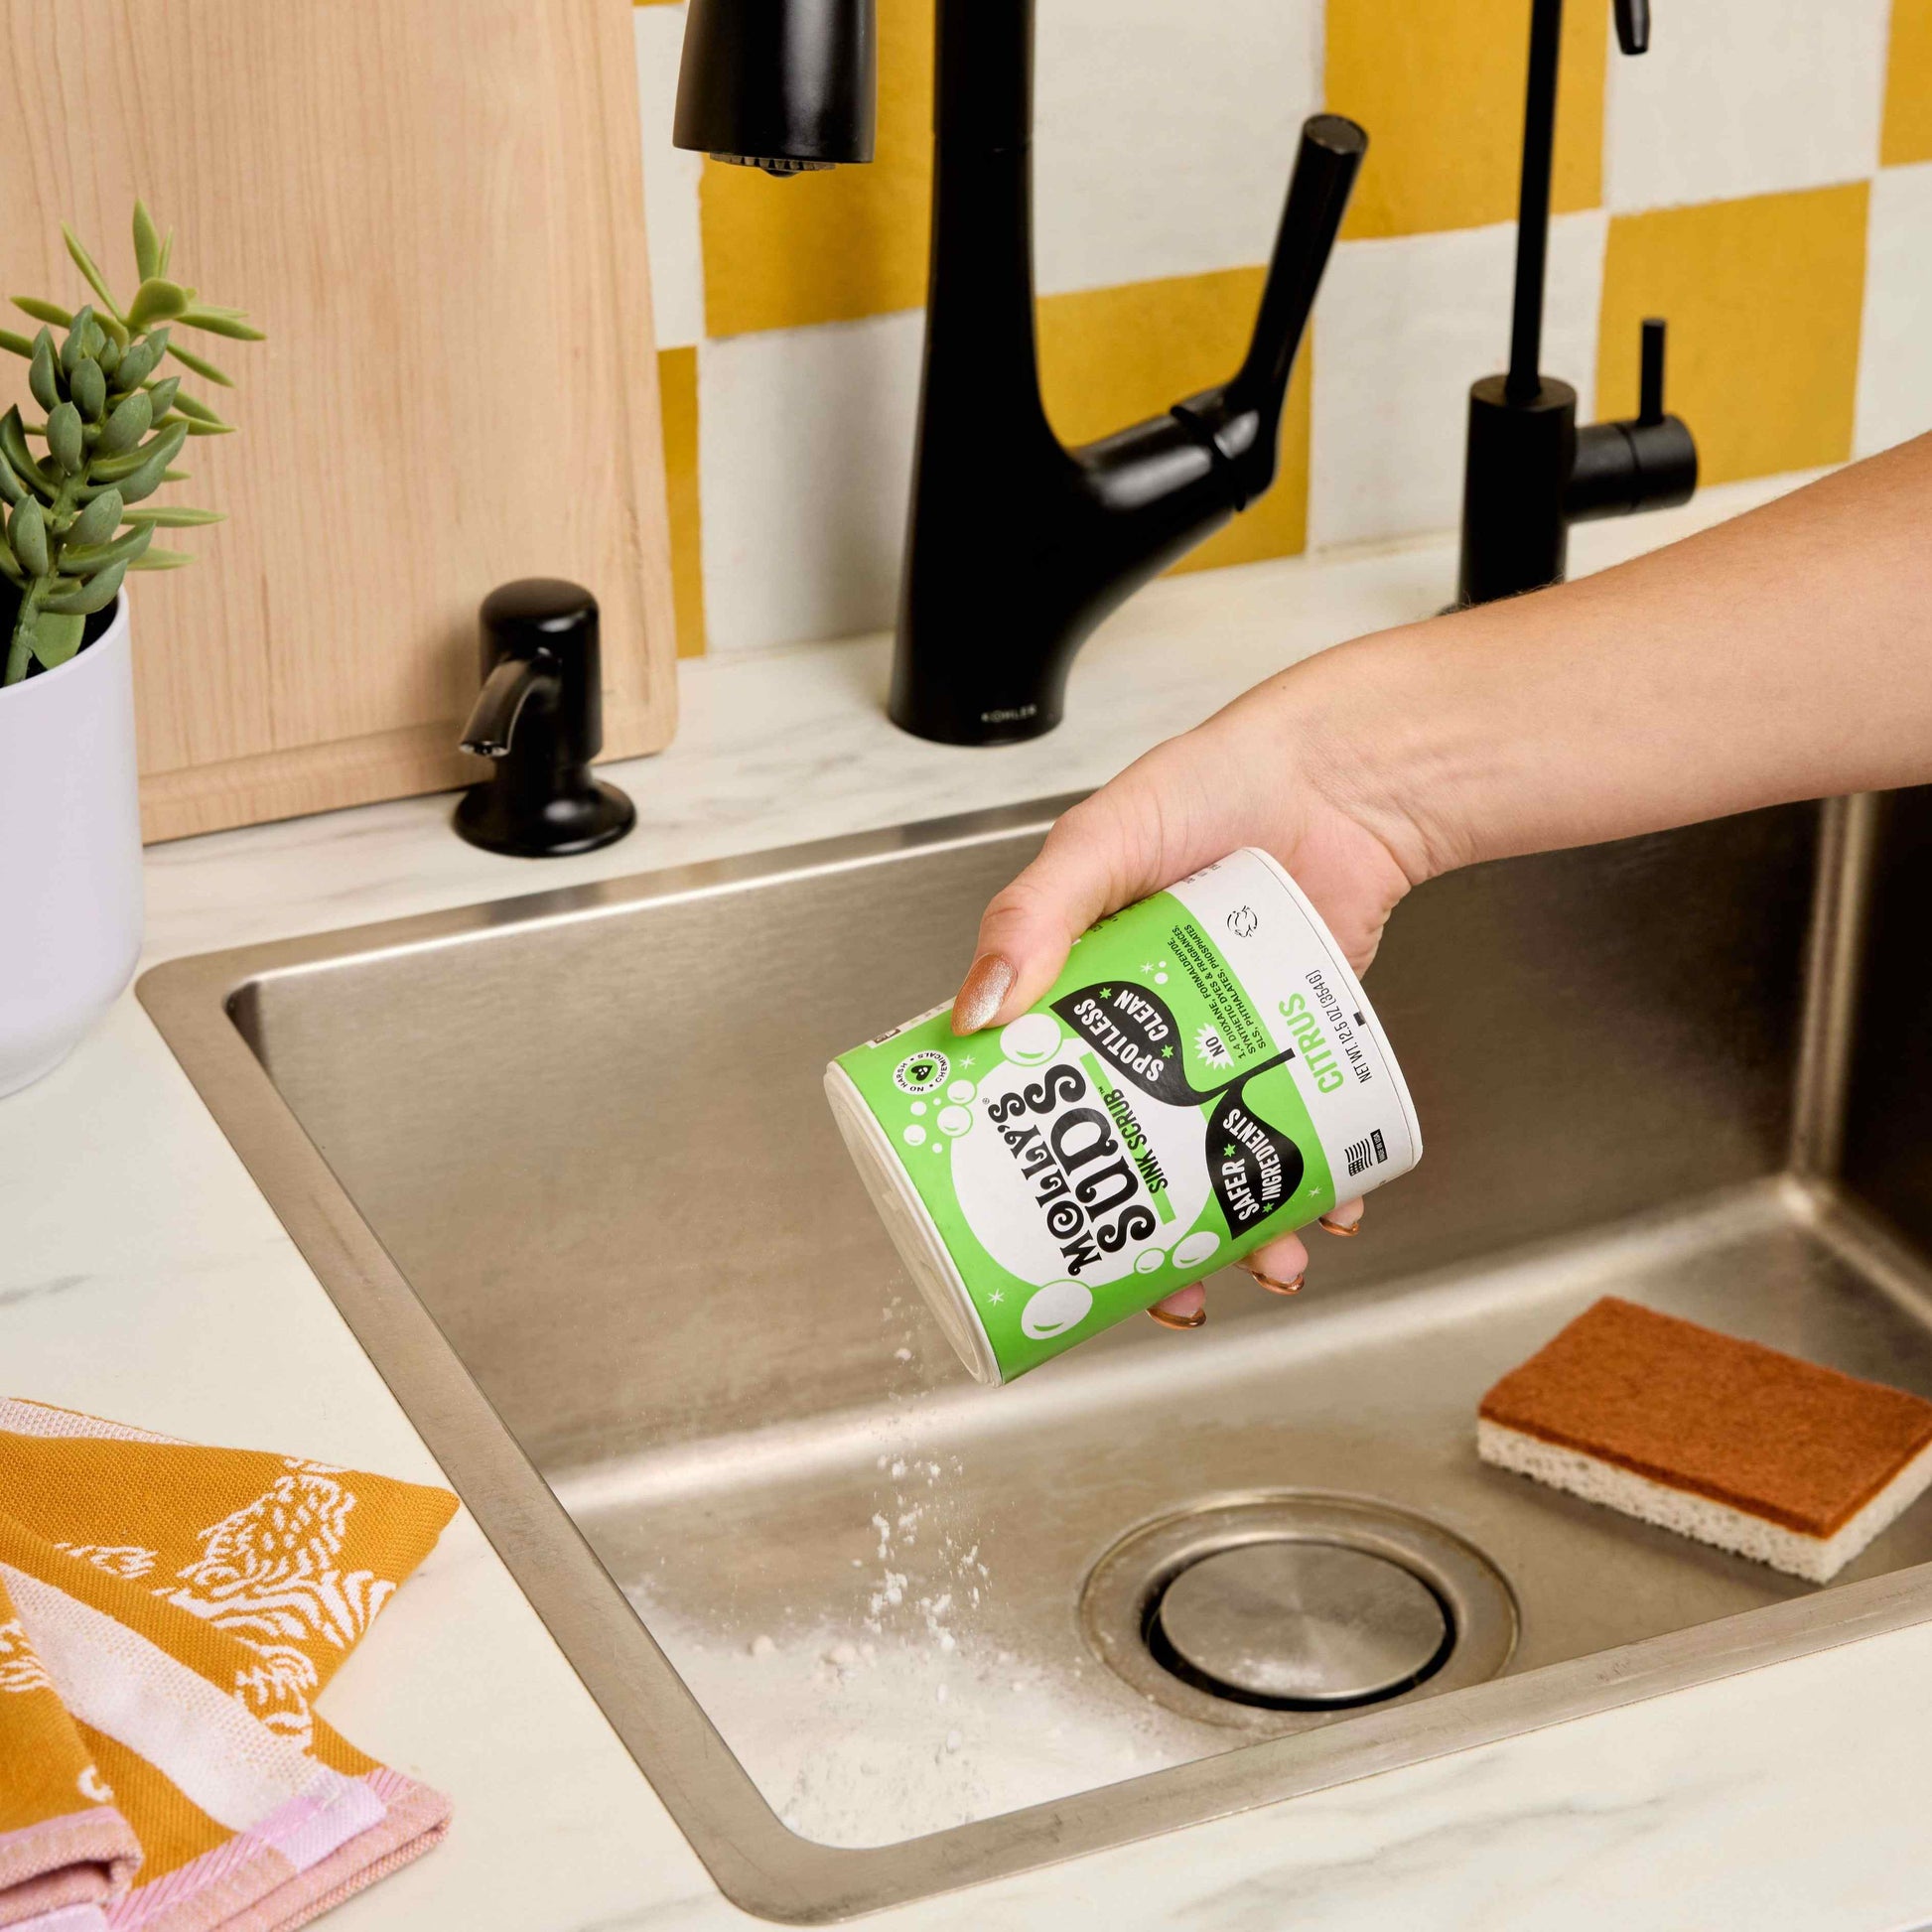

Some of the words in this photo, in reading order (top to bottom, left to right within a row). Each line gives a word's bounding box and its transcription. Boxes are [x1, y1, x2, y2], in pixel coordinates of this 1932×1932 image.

[981, 704, 1036, 723] KOHLER
[1168, 937, 1211, 999] FORMALDEHYDE,
[1172, 924, 1208, 973] FRAGRANCES,
[1183, 924, 1219, 970] PHOSPHATES
[1205, 972, 1213, 981] &
[1209, 981, 1227, 1005] DYES
[1305, 969, 1337, 1009] (354G)
[1113, 989, 1170, 1041] CLEAN
[1217, 969, 1254, 1027] PHTHALATES,
[1326, 1005, 1342, 1023] OZ
[1074, 999, 1165, 1082] SPOTLESS
[1209, 998, 1237, 1042] DIOXANE,
[1224, 1005, 1256, 1054] SYNTHETIC
[1251, 1027, 1267, 1049] SLS,
[1334, 1021, 1354, 1044] 12.5
[1205, 1036, 1225, 1057] NO
[1233, 1043, 1247, 1059] 1,4
[1279, 993, 1344, 1094] CITRUS
[1344, 1041, 1362, 1064] WT.
[896, 1062, 907, 1088] HARSH
[917, 1052, 947, 1082] CHEMICALS
[1353, 1062, 1372, 1084] NET
[1023, 1064, 1156, 1253] SUDS
[1135, 1149, 1168, 1193] SINK
[1223, 1108, 1283, 1201] INGREDIENTS
[1221, 1158, 1260, 1221] SAFER
